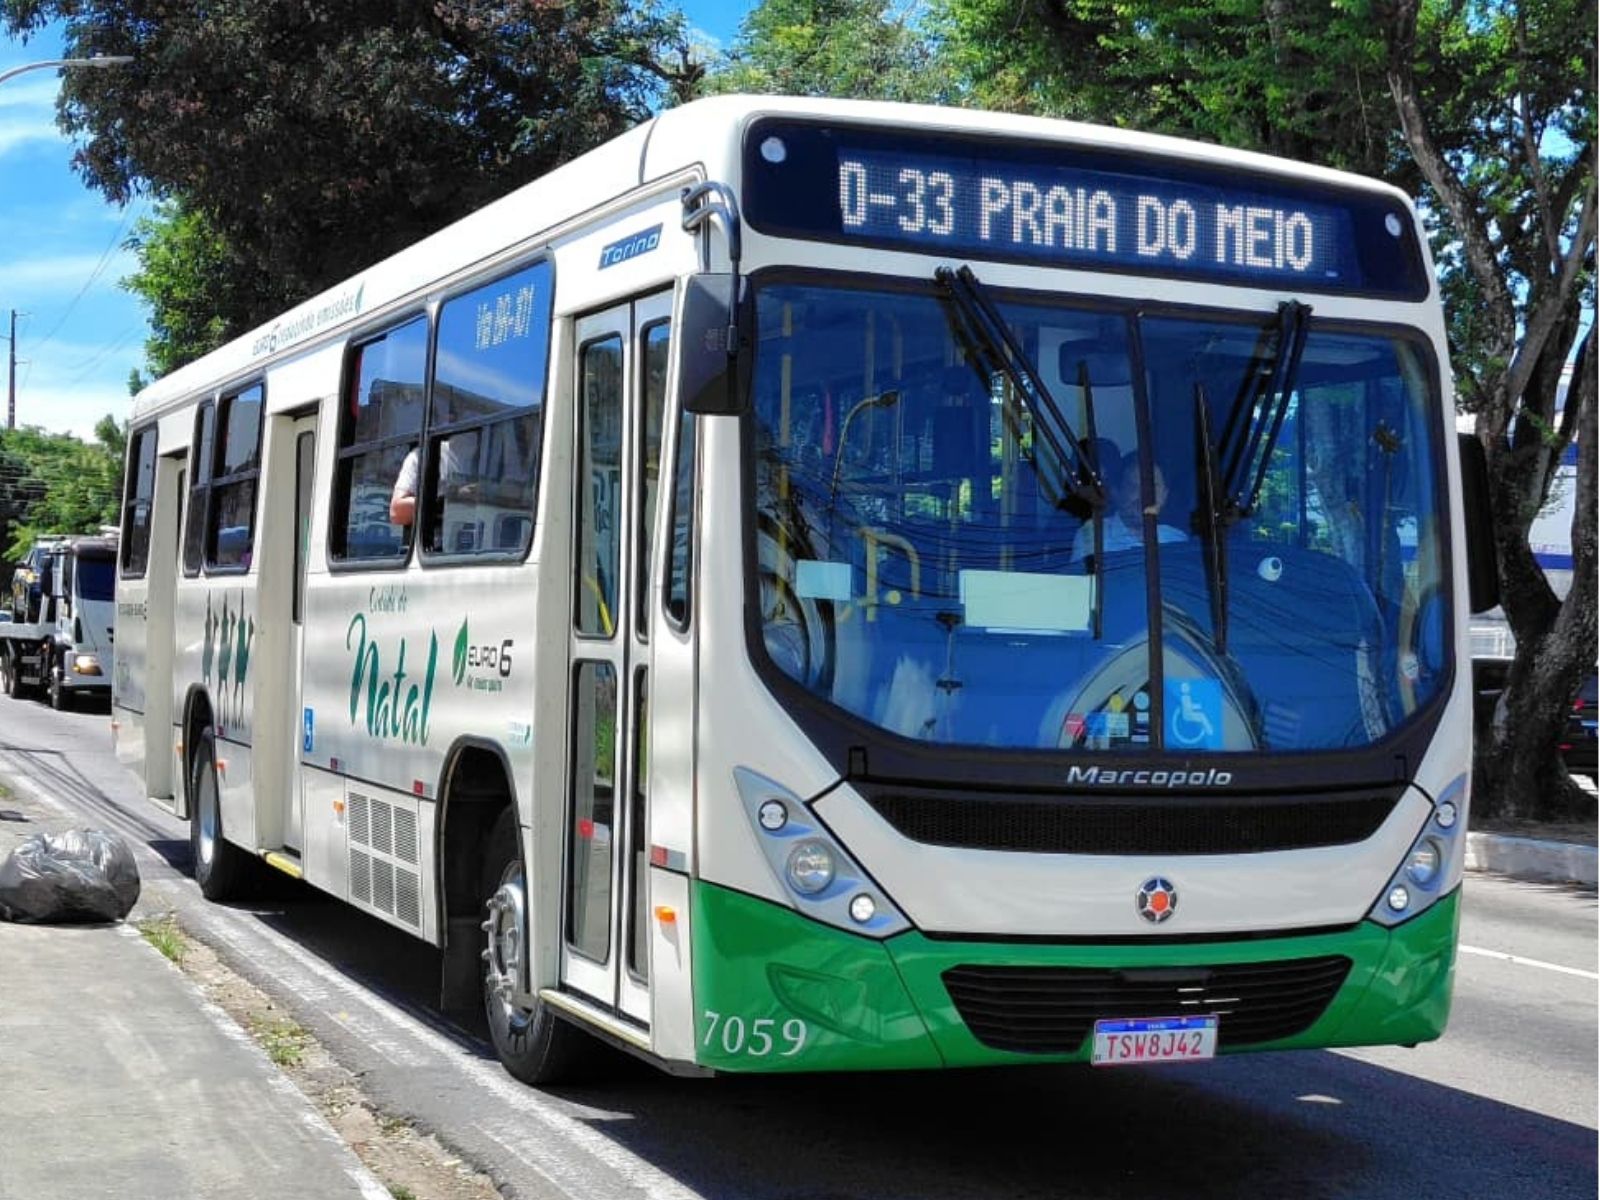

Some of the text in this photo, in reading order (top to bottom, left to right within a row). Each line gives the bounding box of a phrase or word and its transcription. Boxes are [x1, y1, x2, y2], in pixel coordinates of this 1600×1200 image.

[980, 177, 1117, 253] PRAIA
[1137, 195, 1197, 260] DO
[1216, 203, 1314, 272] MEIO
[603, 233, 660, 265] Torino
[346, 612, 438, 746] Natal
[1066, 765, 1232, 788] Marcopolo
[703, 1009, 808, 1057] 7059
[1106, 1031, 1203, 1060] TSW8J42
